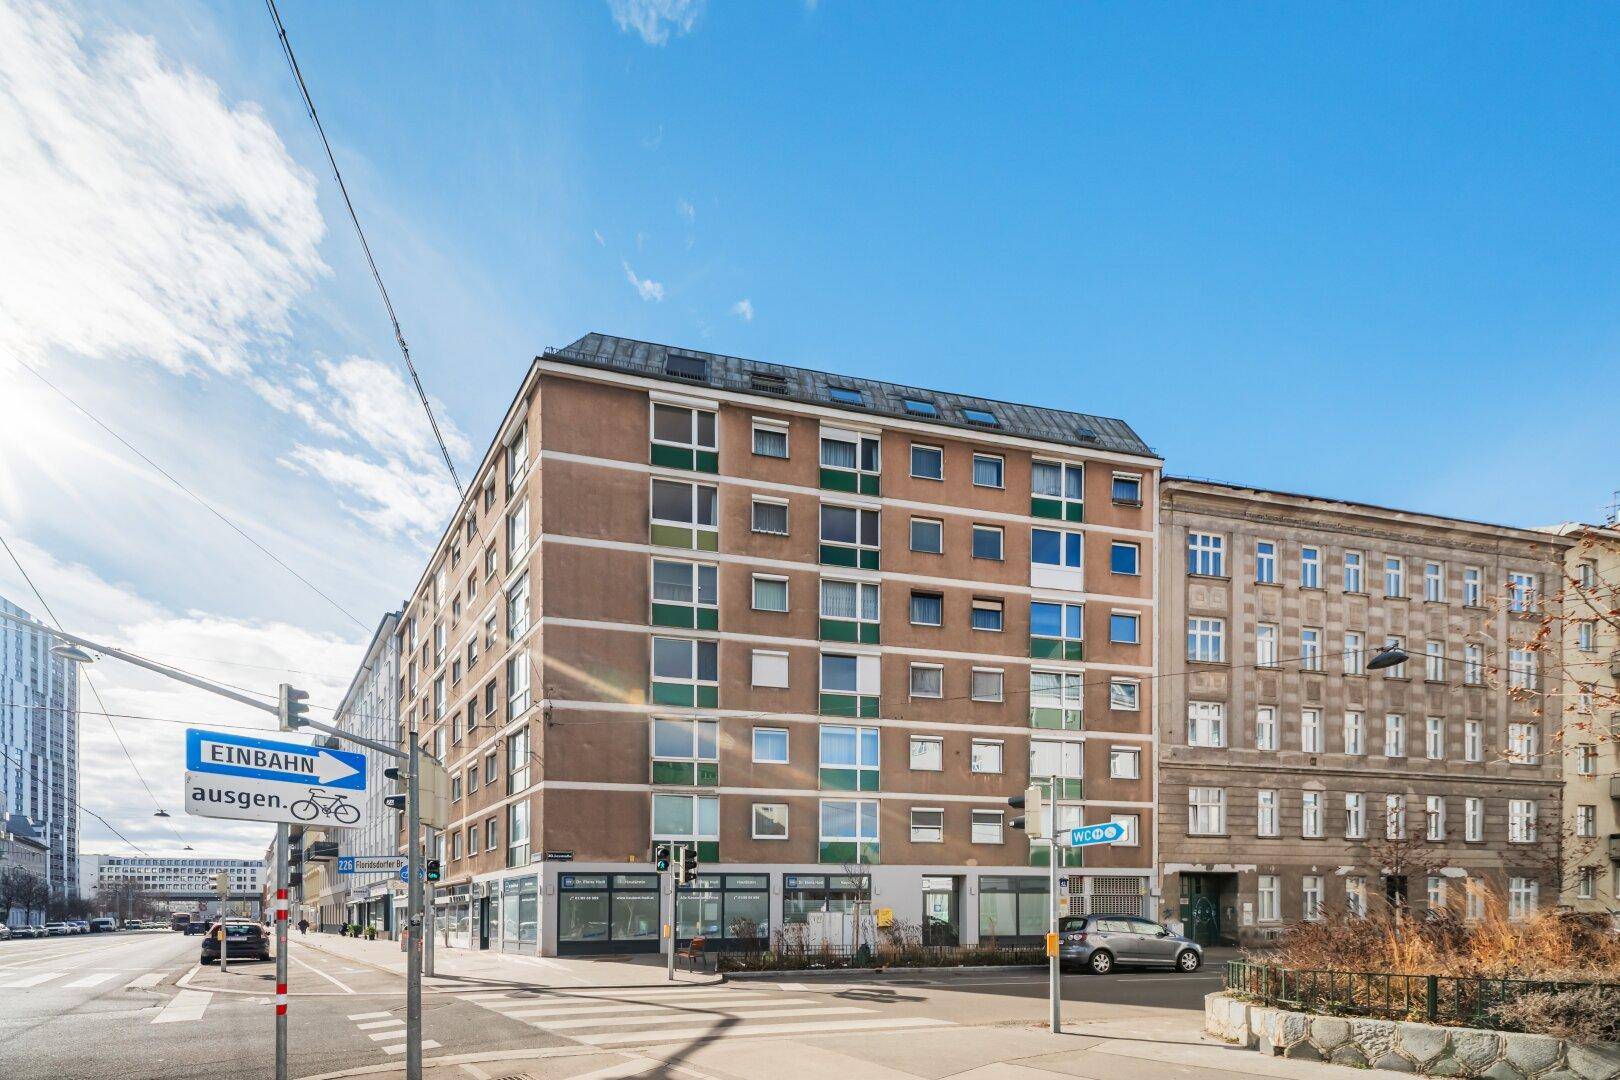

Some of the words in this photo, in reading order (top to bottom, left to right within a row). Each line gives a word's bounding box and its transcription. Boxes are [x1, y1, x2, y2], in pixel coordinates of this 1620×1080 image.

[211, 744, 314, 774] EINBAHN
[191, 786, 288, 809] ausgen.
[1073, 830, 1092, 843] WC
[338, 860, 353, 871] 226
[355, 860, 395, 869] Floridsdorfer
